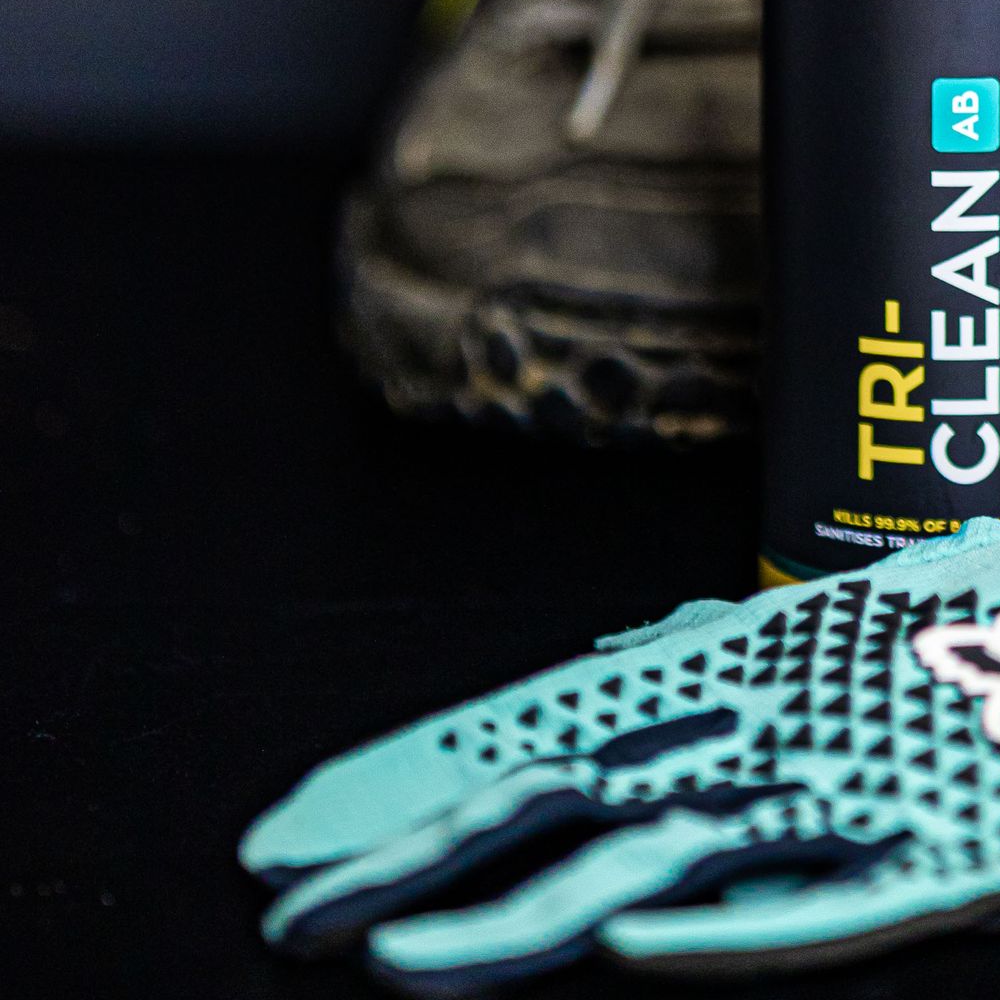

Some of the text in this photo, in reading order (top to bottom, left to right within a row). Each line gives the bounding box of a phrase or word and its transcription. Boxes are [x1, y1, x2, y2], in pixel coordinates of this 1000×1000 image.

[951, 89, 980, 141] AB
[930, 170, 1000, 486] CLEAN
[858, 299, 925, 481] TRI-
[814, 521, 884, 548] SANITISES
[833, 509, 873, 528] KILLS
[874, 514, 921, 532] 99.9%
[923, 518, 947, 534] OF
